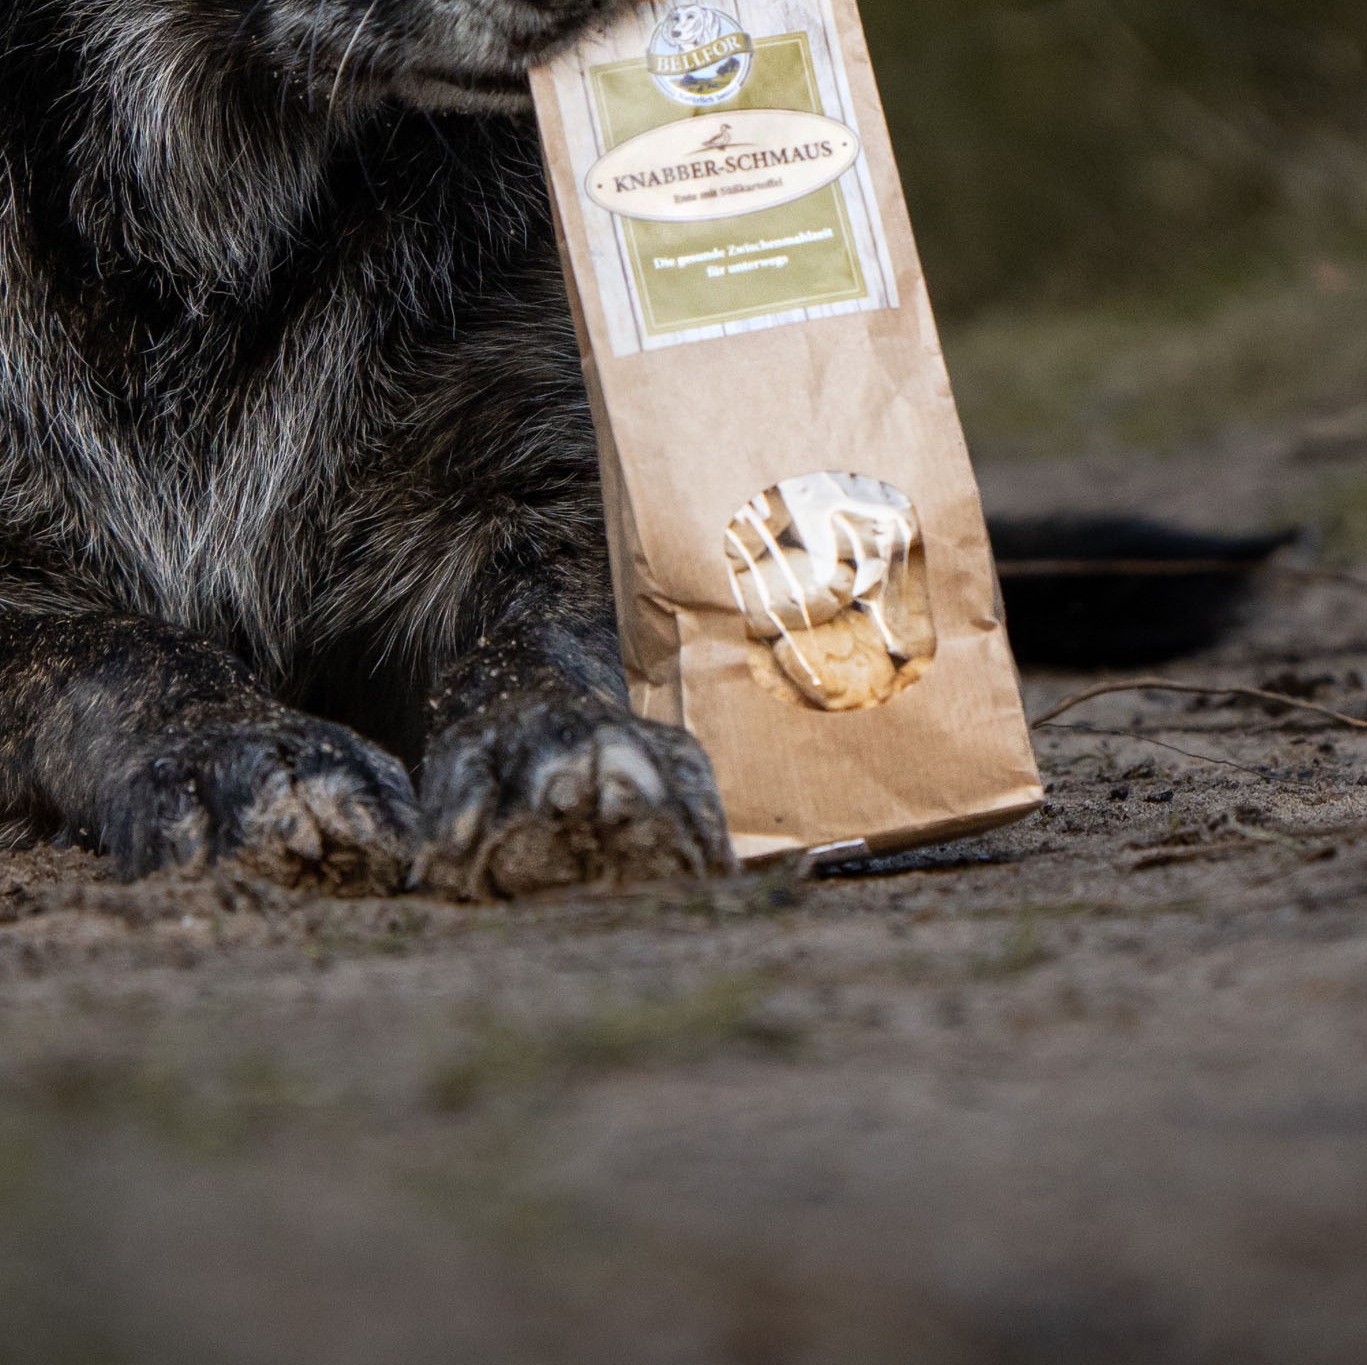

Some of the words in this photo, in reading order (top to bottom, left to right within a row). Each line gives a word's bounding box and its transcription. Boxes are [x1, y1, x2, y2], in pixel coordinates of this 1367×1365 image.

[656, 34, 742, 71] BELLFOR
[613, 140, 833, 193] KNABBER-SCHMAUS
[700, 188, 717, 199] mit
[653, 257, 675, 269] Die
[677, 248, 725, 268] gesunde
[727, 227, 833, 257] Zwischenmahlzeit
[706, 265, 725, 277] für
[727, 255, 789, 273] unterwegs
